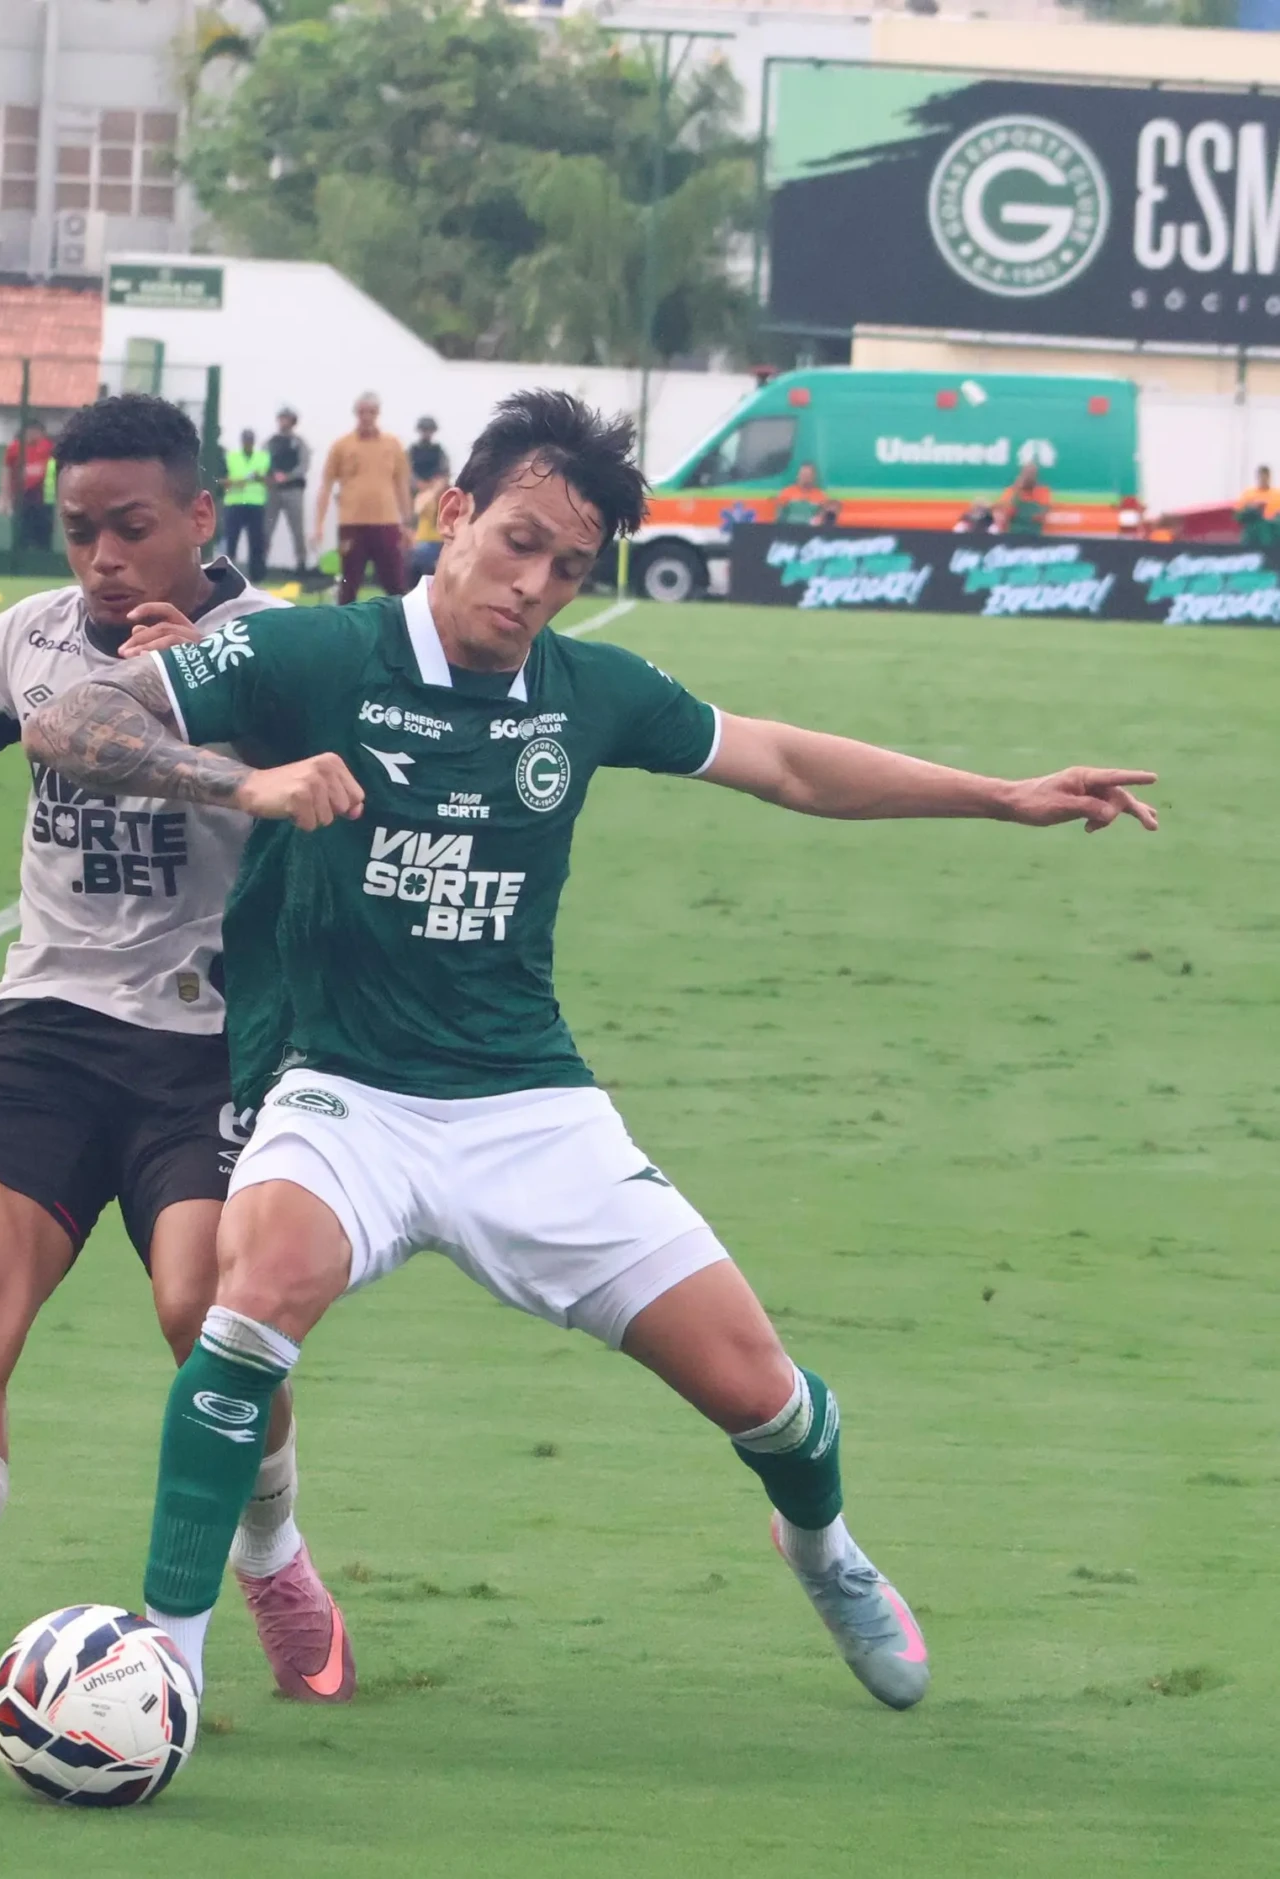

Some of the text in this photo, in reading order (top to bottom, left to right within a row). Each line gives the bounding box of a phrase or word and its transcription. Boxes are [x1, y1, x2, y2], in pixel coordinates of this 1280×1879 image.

[875, 434, 1010, 466] Unimed
[402, 720, 442, 741] SOLAR
[403, 710, 454, 733] ENERGIA
[525, 742, 560, 759] ESPORTE
[557, 754, 568, 789] CLUBE
[437, 803, 491, 819] SORTE
[449, 792, 483, 805] VIVA
[32, 801, 188, 853] SORTE
[369, 826, 474, 870] VIVA
[71, 853, 188, 898] .BET
[362, 860, 527, 908] SORTE
[410, 904, 516, 942] .BET
[83, 1660, 146, 1692] uhlsport
